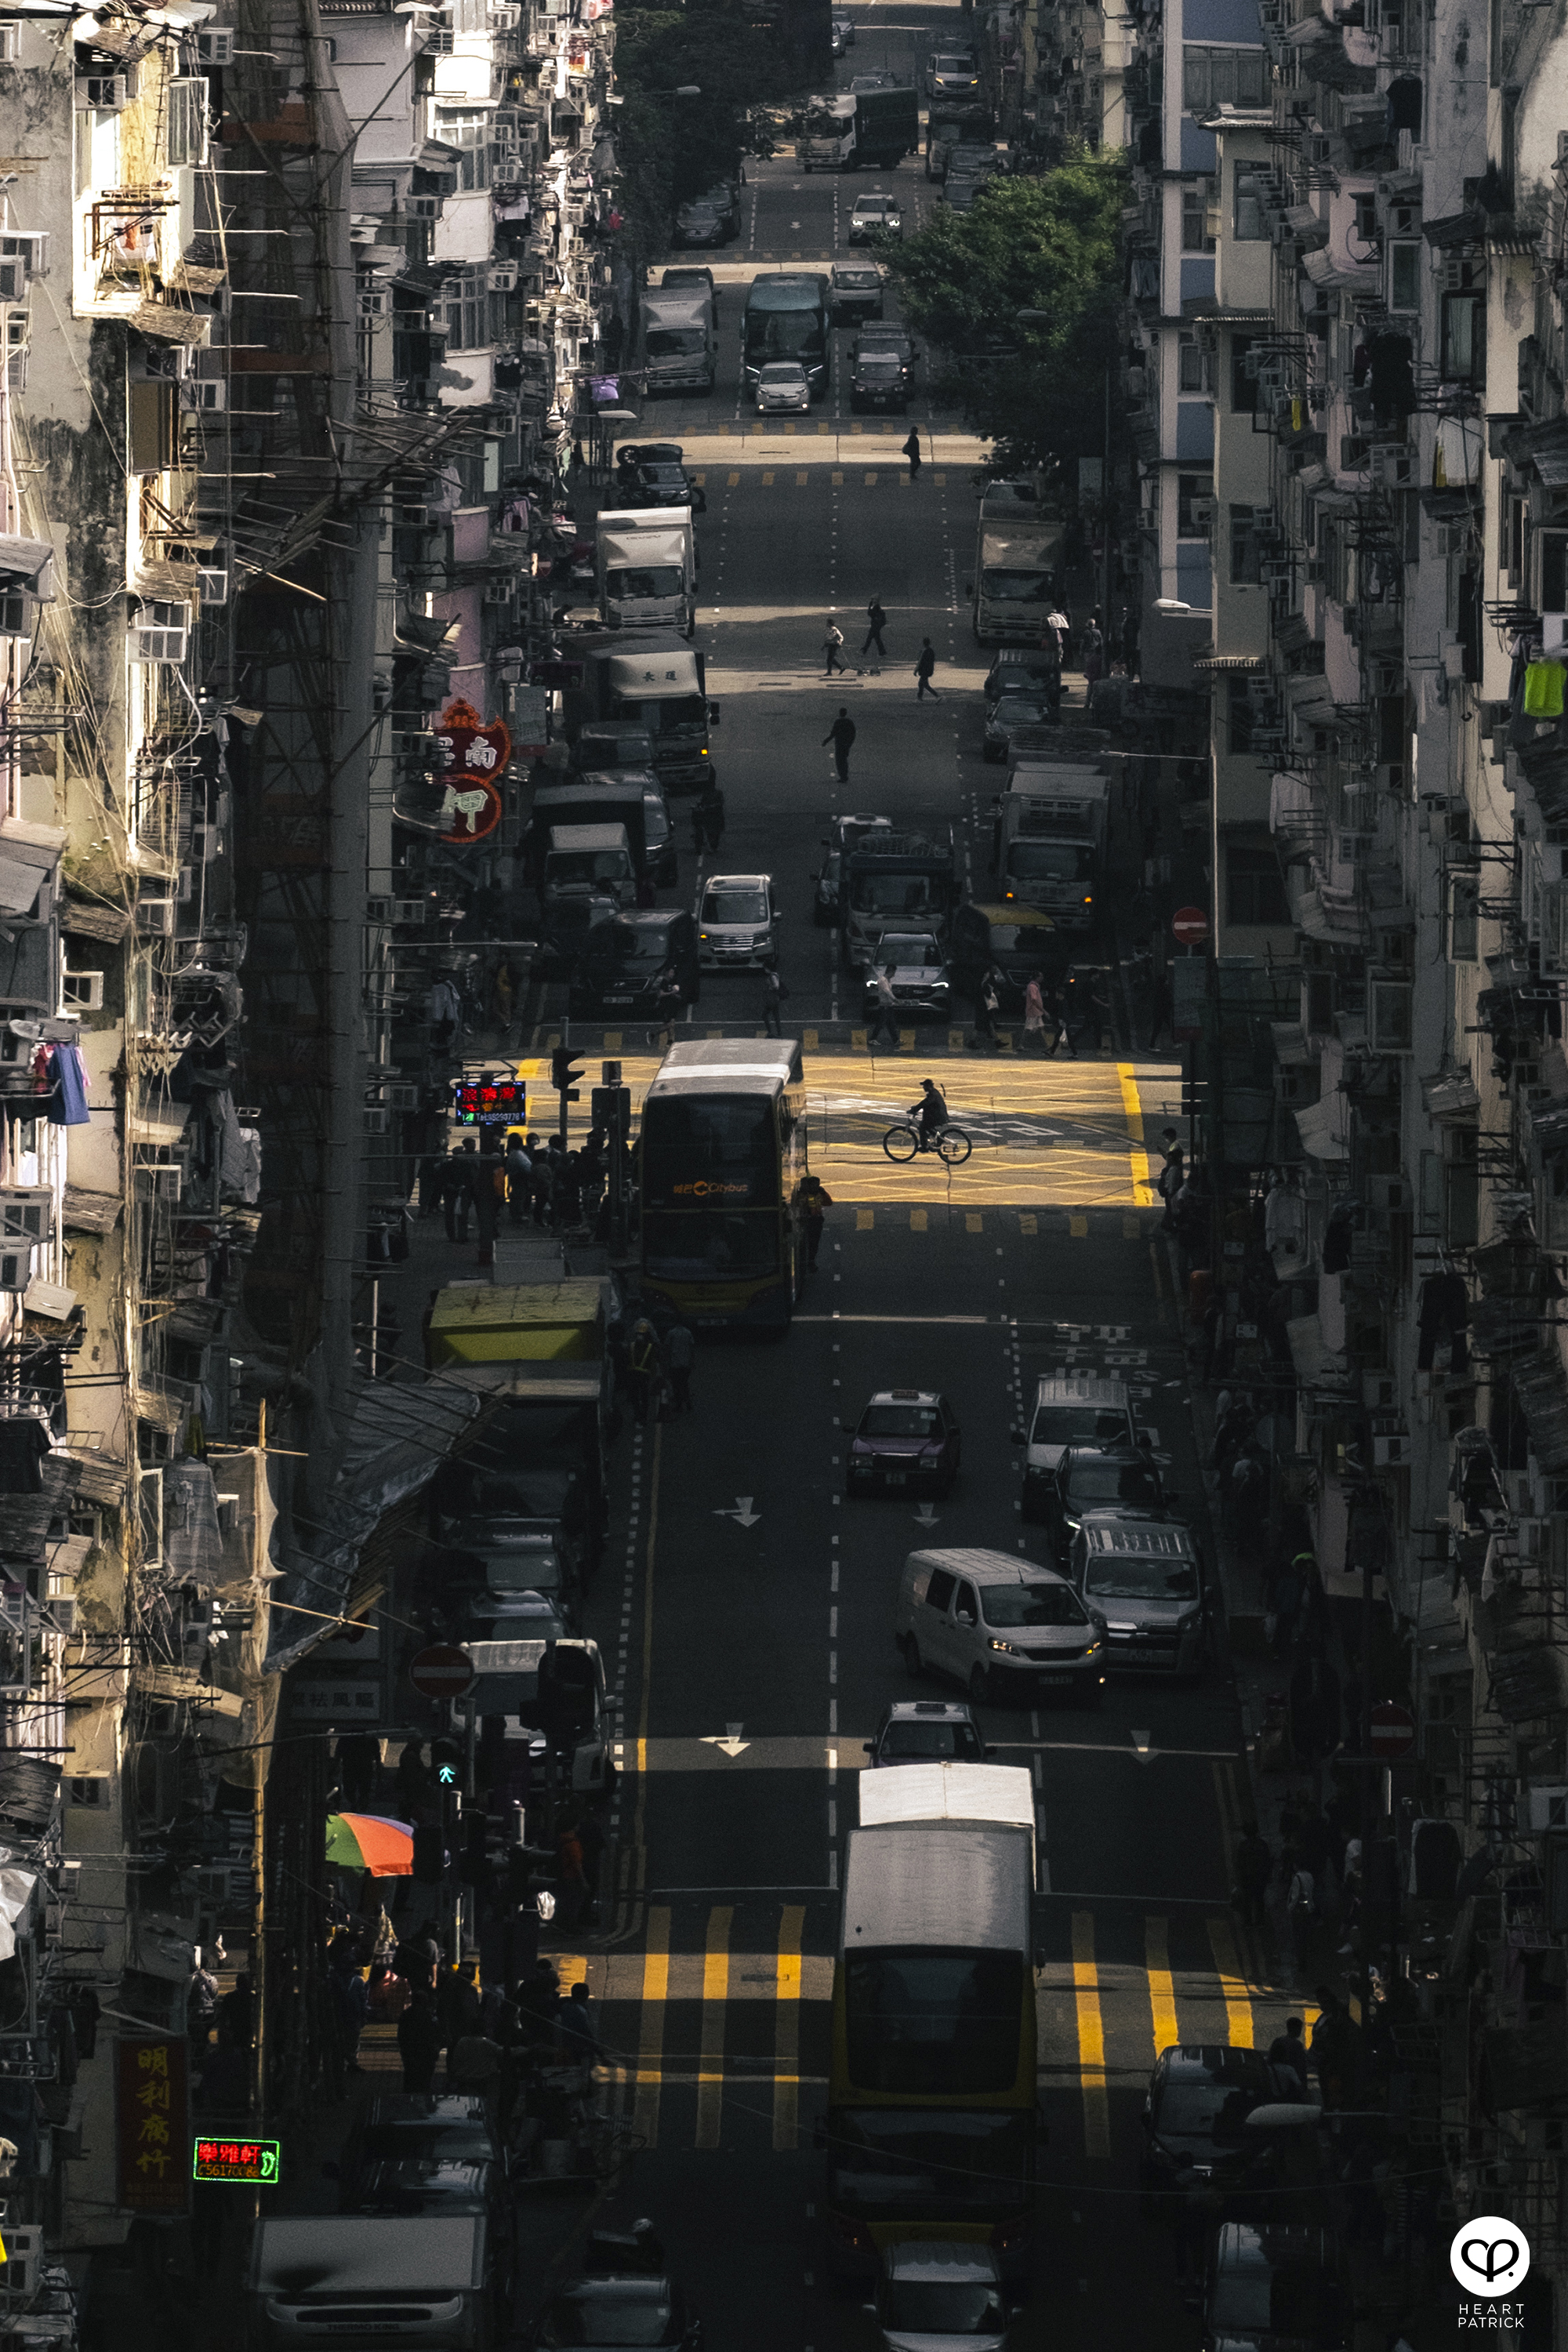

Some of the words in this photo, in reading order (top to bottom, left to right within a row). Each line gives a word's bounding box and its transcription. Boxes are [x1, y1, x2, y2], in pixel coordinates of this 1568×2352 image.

[708, 1182, 749, 1194] Citybus
[136, 2045, 172, 2179] 明利腐竹
[198, 2142, 262, 2165] 樂雅軒
